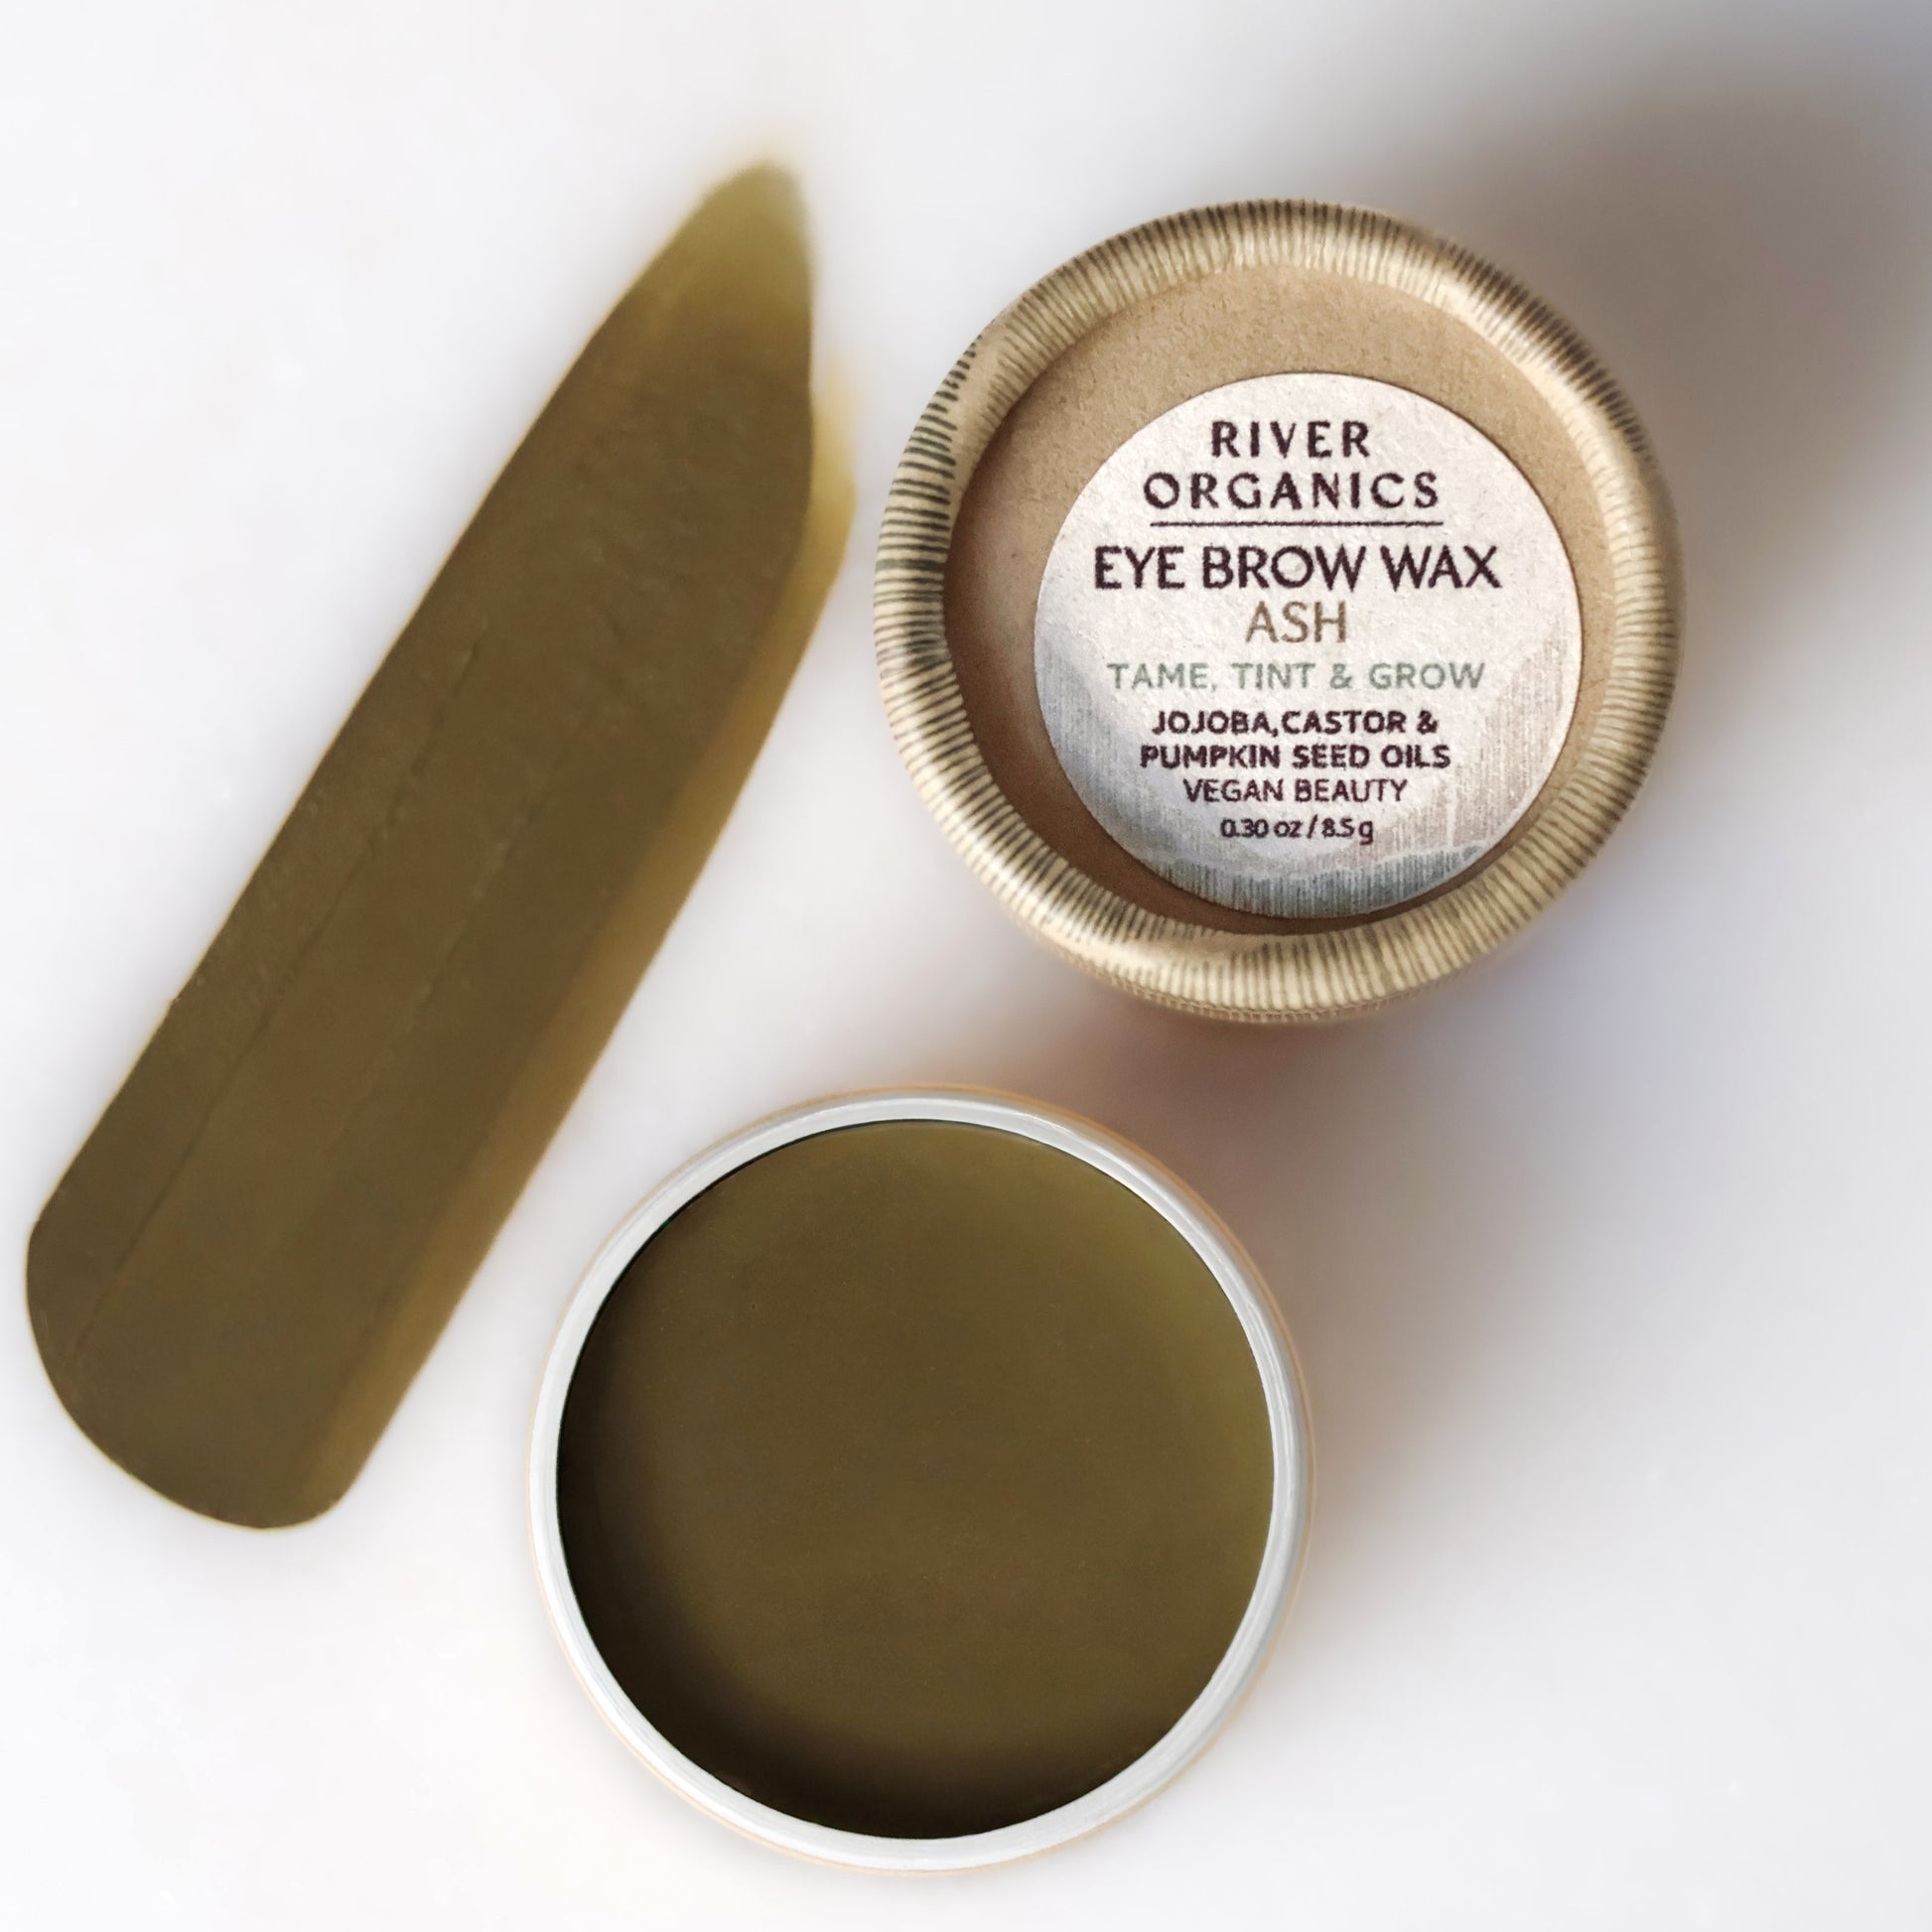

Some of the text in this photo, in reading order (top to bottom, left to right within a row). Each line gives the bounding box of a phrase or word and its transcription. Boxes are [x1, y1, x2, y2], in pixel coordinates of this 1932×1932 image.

[1211, 420, 1370, 458] RIVER
[1144, 471, 1440, 510] ORGANICS
[1094, 545, 1503, 592] EYE BROW WAX
[1246, 601, 1347, 643] ASH
[1107, 662, 1486, 692] TAME, TINT & GROW
[1416, 710, 1439, 734] &
[1140, 744, 1451, 769] PUMPKIN SEED OILS
[1182, 778, 1408, 803] VEGAN BEAUTY
[1275, 820, 1301, 839] oz
